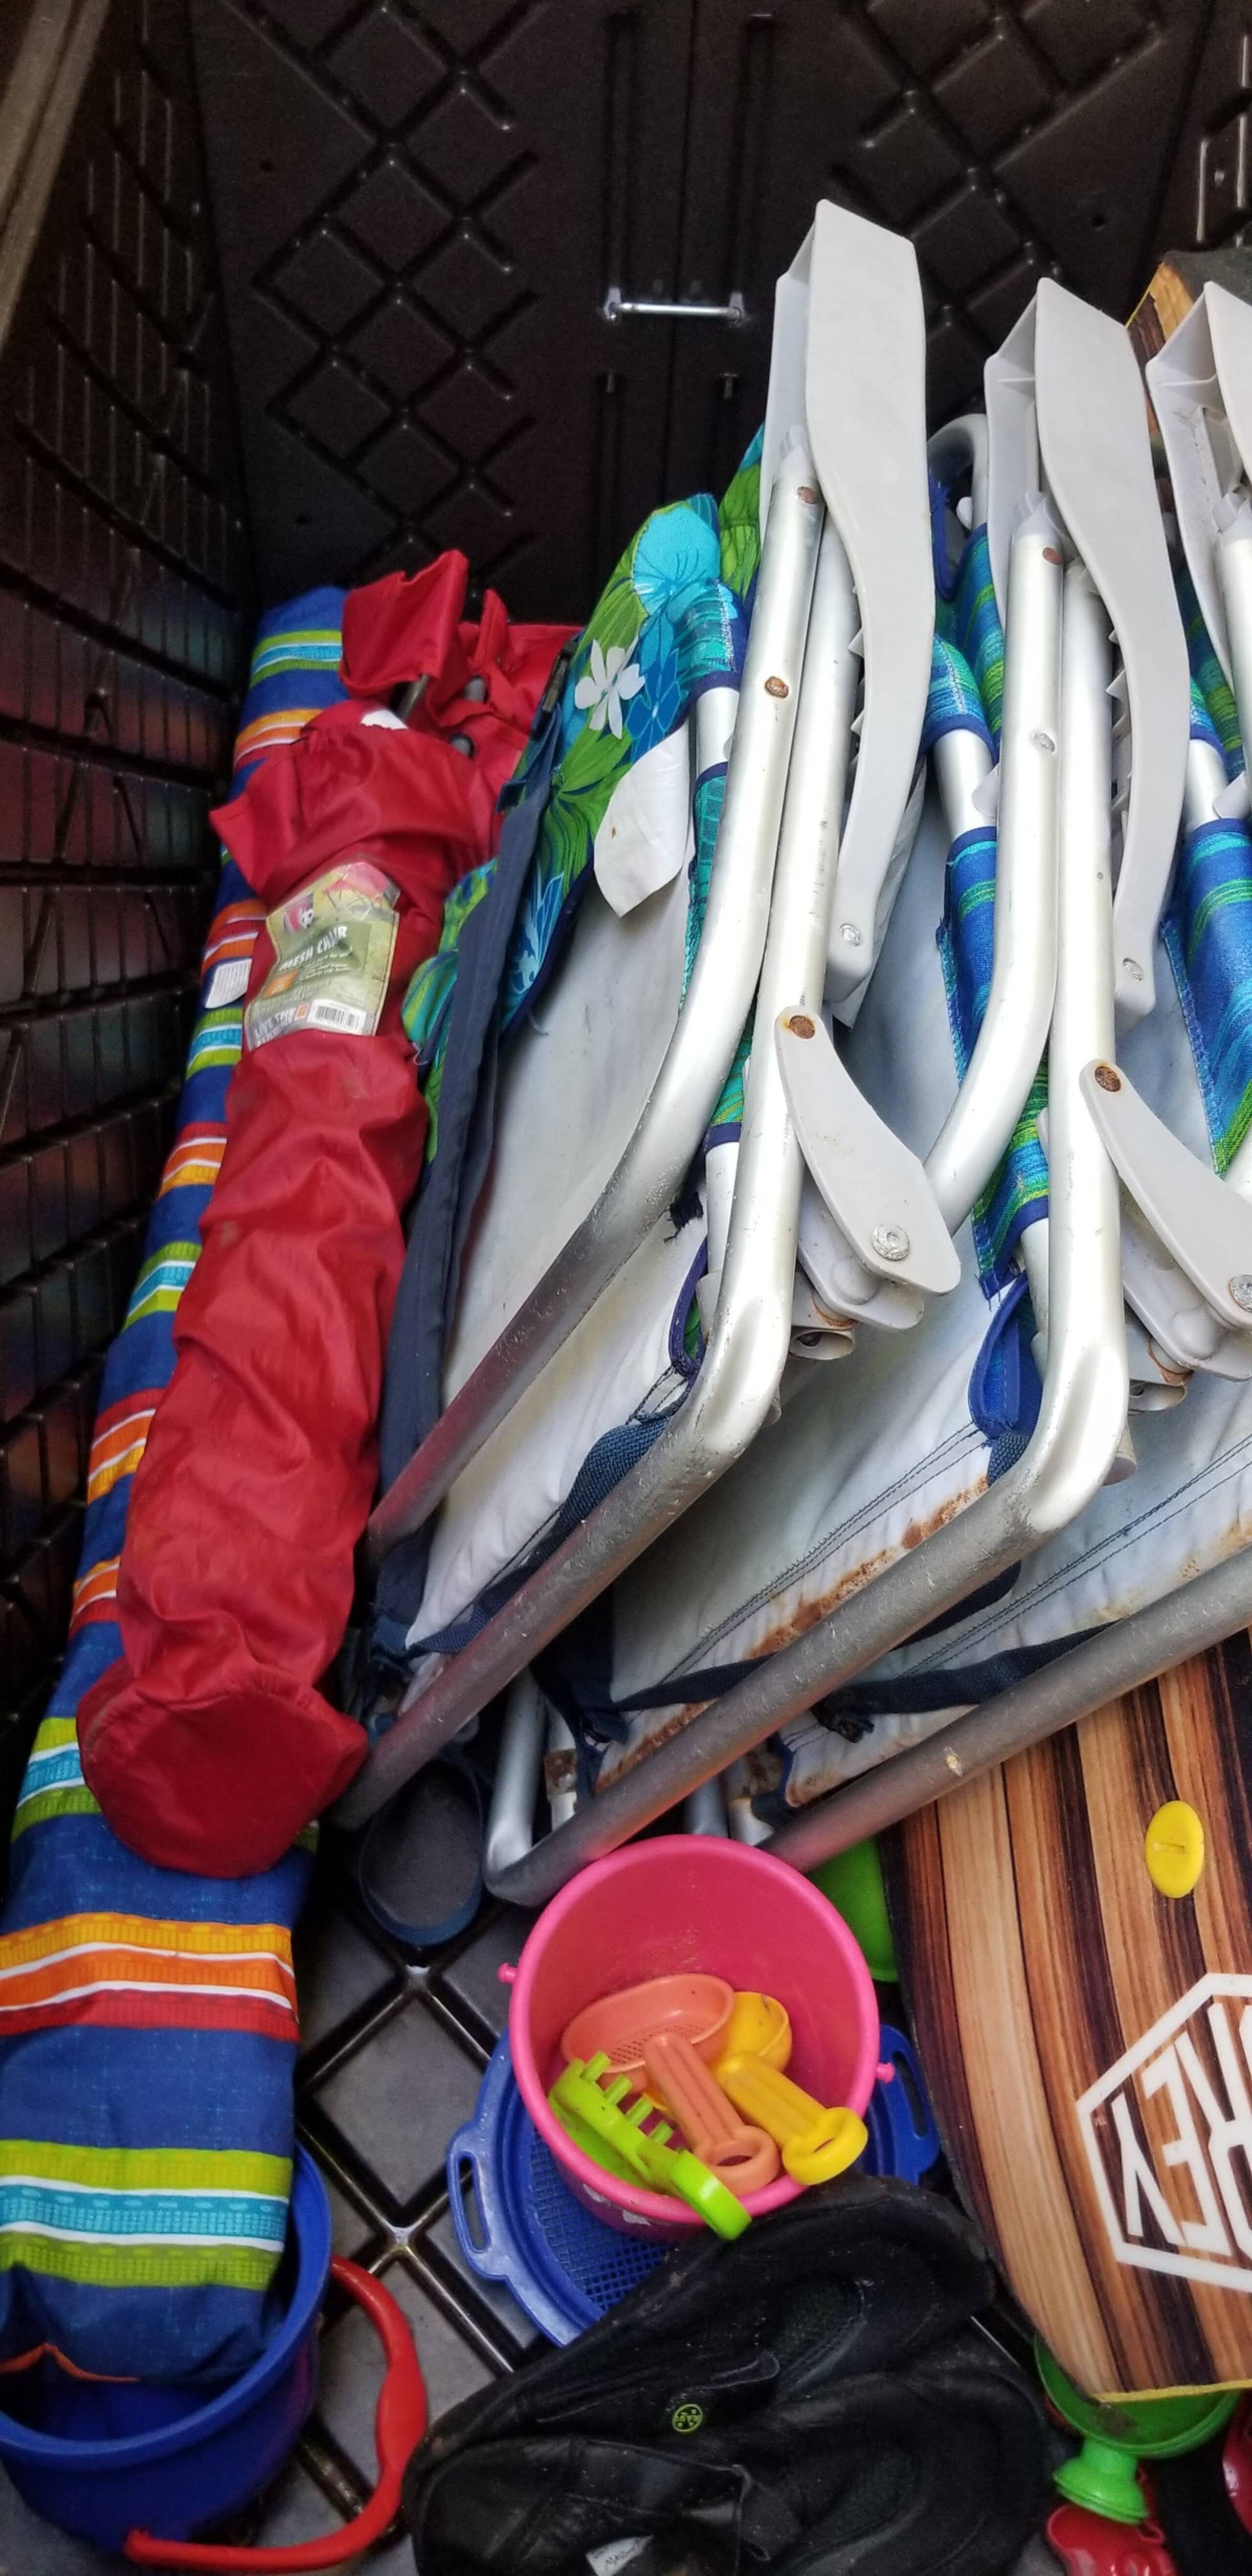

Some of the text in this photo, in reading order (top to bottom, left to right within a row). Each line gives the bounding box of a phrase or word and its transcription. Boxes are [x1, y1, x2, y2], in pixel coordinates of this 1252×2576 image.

[280, 949, 313, 971] MESH
[317, 926, 348, 951] CHAIR
[1111, 2002, 1252, 2262] REY
